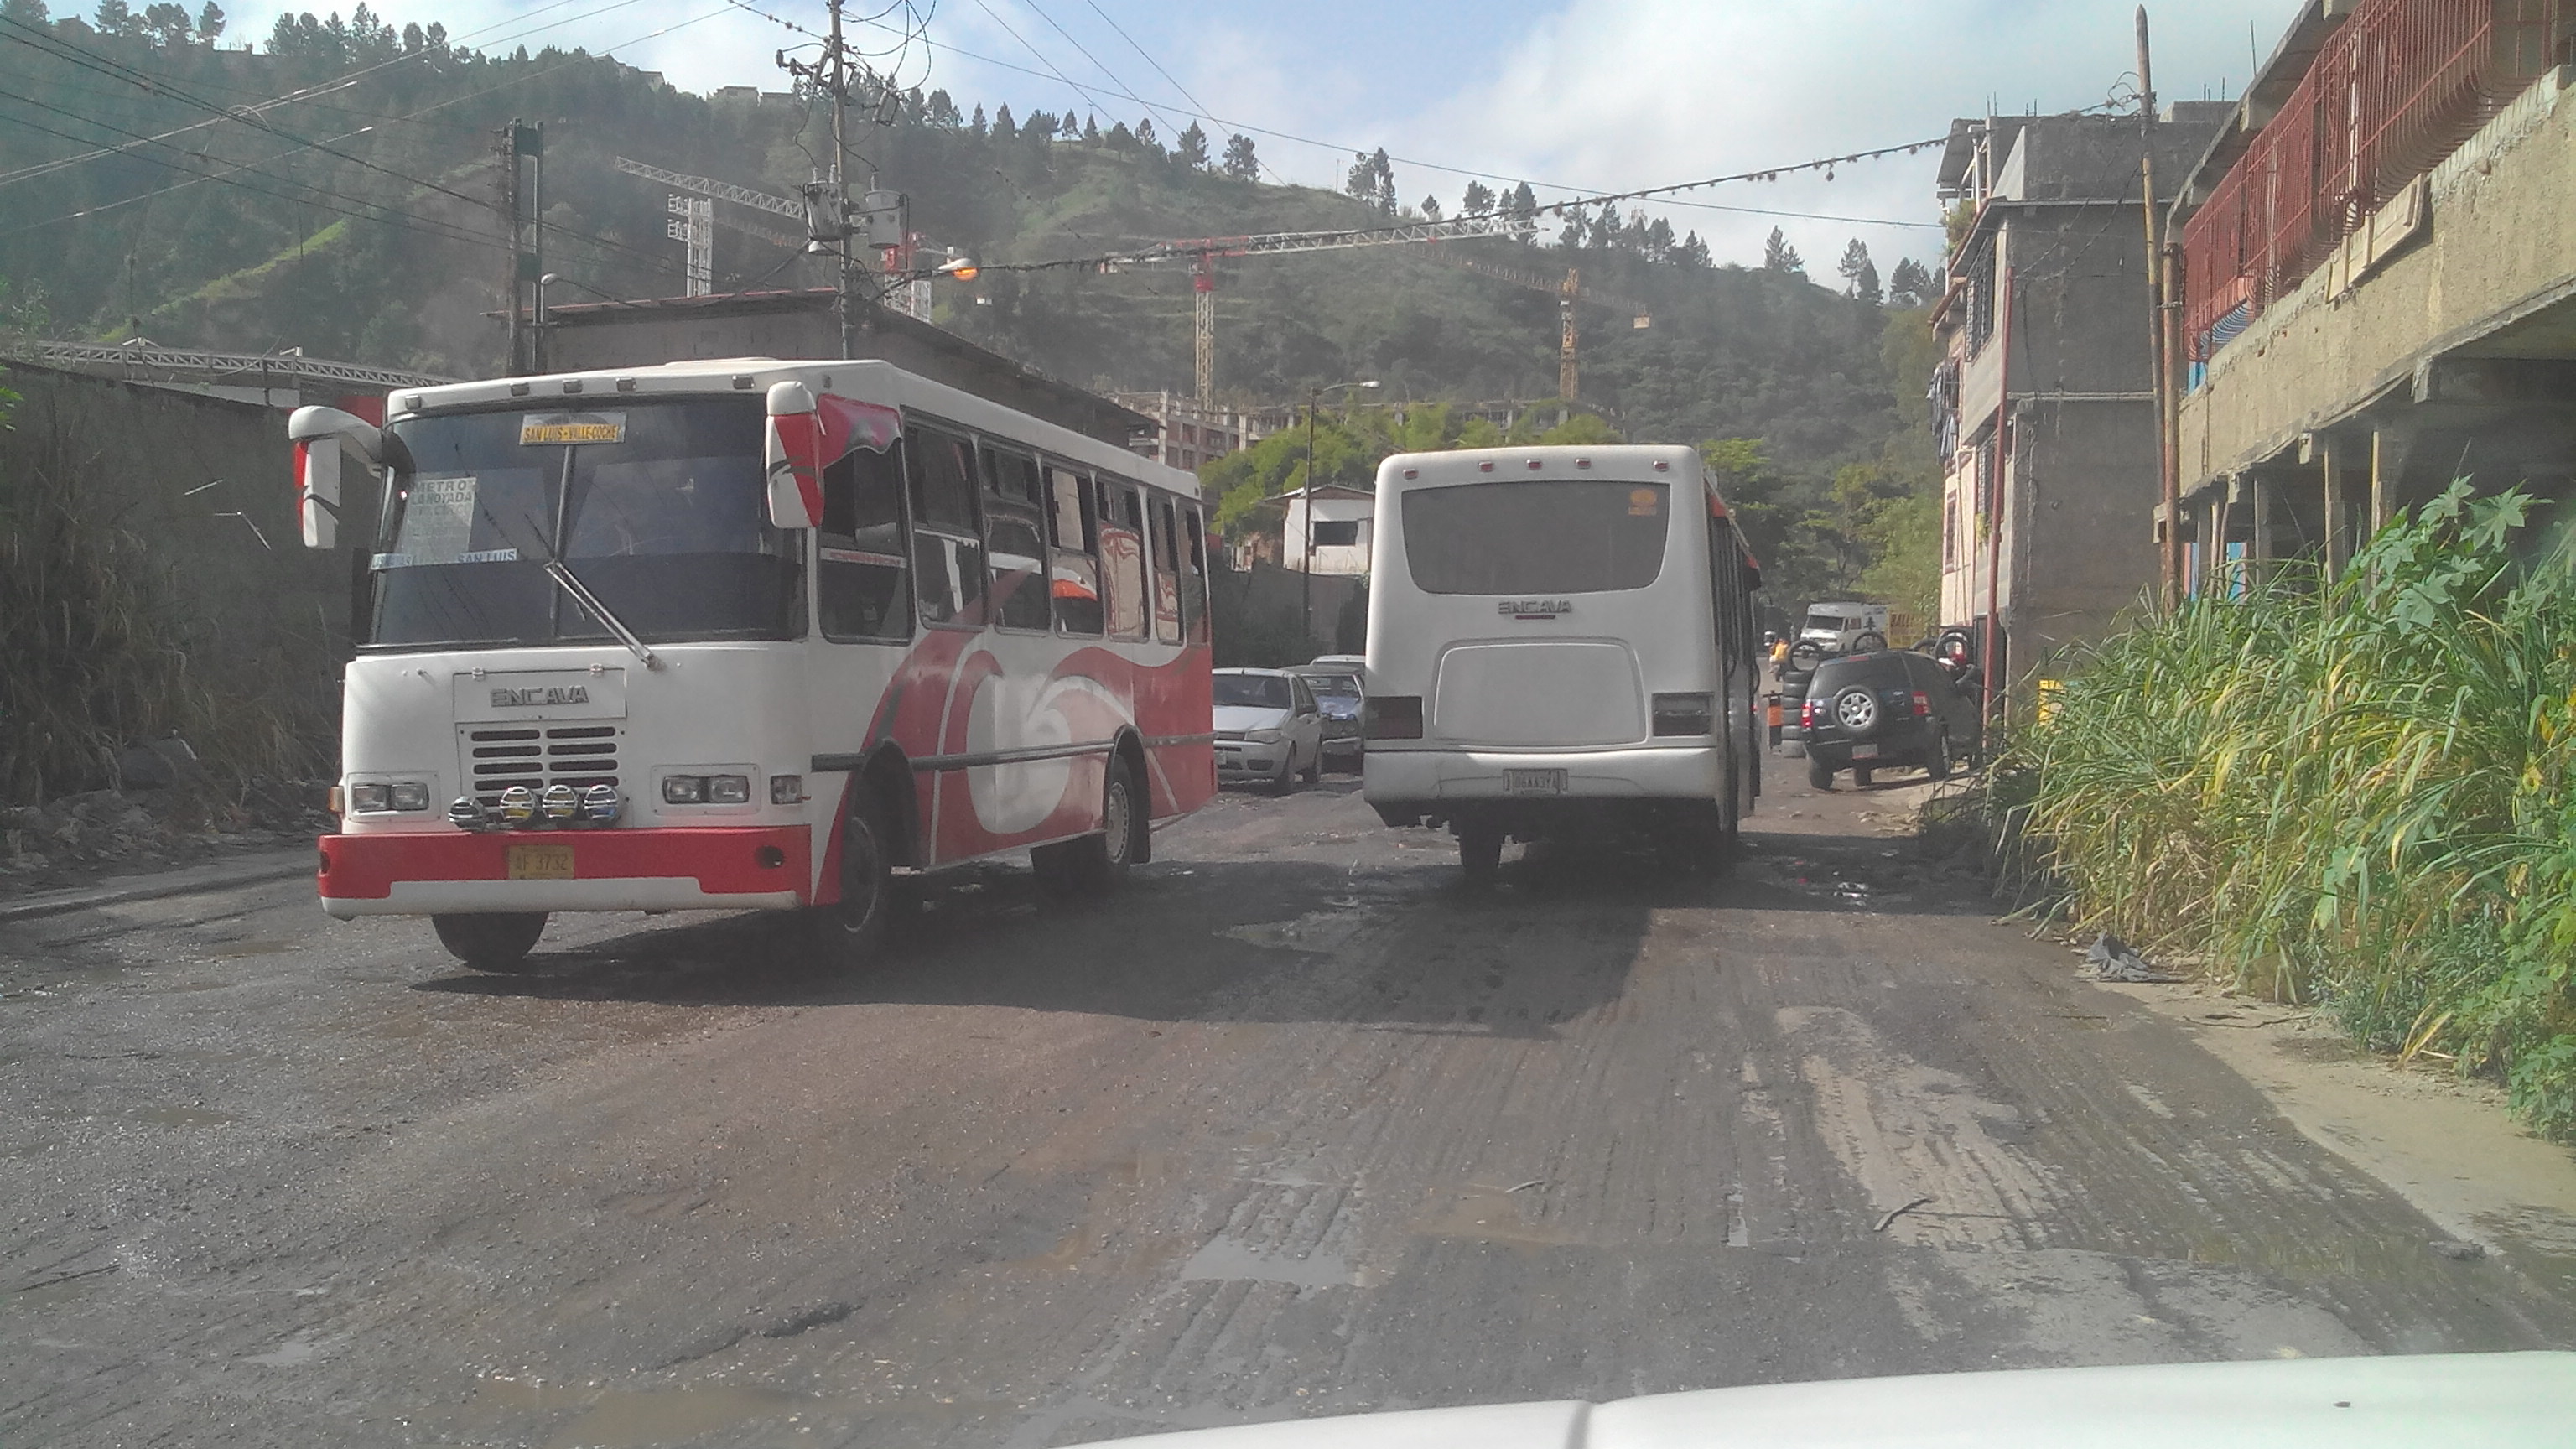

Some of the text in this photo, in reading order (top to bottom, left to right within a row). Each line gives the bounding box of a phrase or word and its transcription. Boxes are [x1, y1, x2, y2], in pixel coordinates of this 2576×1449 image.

[523, 428, 543, 441] SAN
[543, 426, 564, 440] LUIS
[413, 480, 467, 492] METRO
[457, 550, 516, 564] SAN LUIS
[1498, 600, 1572, 614] ENCAVA
[490, 686, 589, 707] ENCAVA
